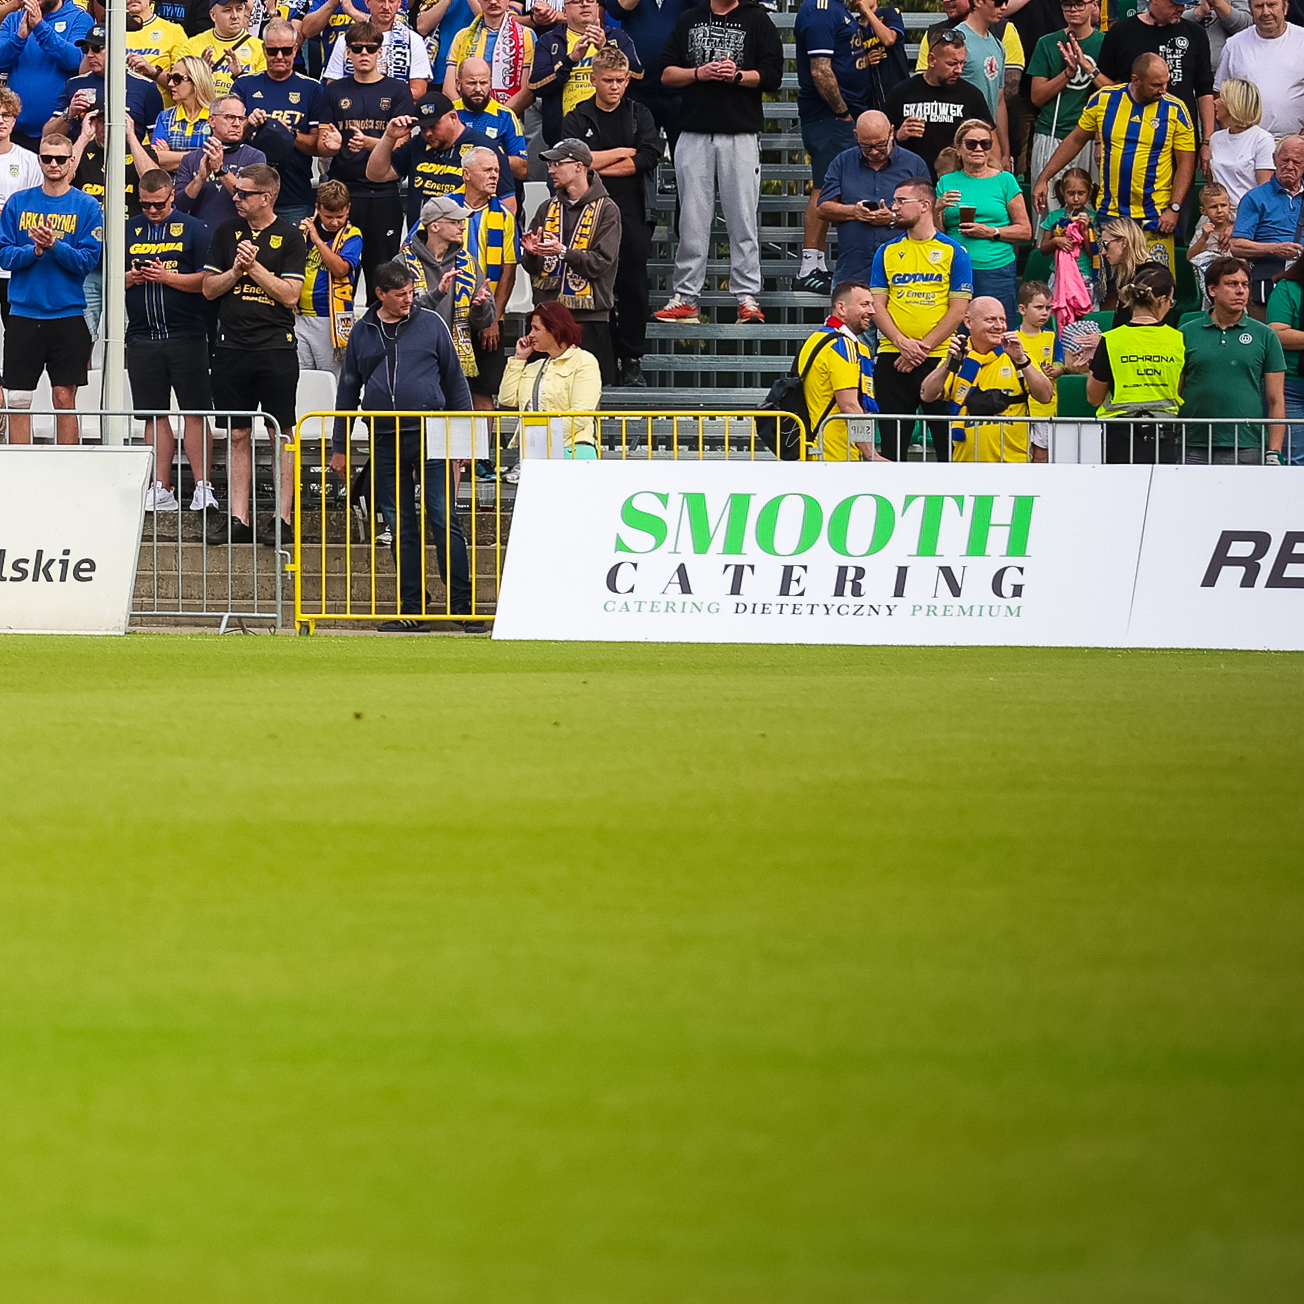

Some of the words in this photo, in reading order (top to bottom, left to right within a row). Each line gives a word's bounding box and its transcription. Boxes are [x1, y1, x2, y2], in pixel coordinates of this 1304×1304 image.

[416, 161, 463, 176] GDYNIA
[424, 178, 456, 192] Energa
[19, 211, 44, 232] ARKA
[129, 242, 183, 255] GDYNIA
[892, 274, 943, 284] GDYNIA
[906, 290, 936, 299] Energa
[1121, 355, 1175, 364] OCHRONA
[1136, 368, 1161, 376] LION
[615, 492, 1040, 558] SMOOTH
[606, 562, 1025, 599] CATERING
[603, 600, 722, 615] CATERING
[733, 602, 898, 618] DIETETYCZNY
[910, 603, 1023, 618] PREMIUM
